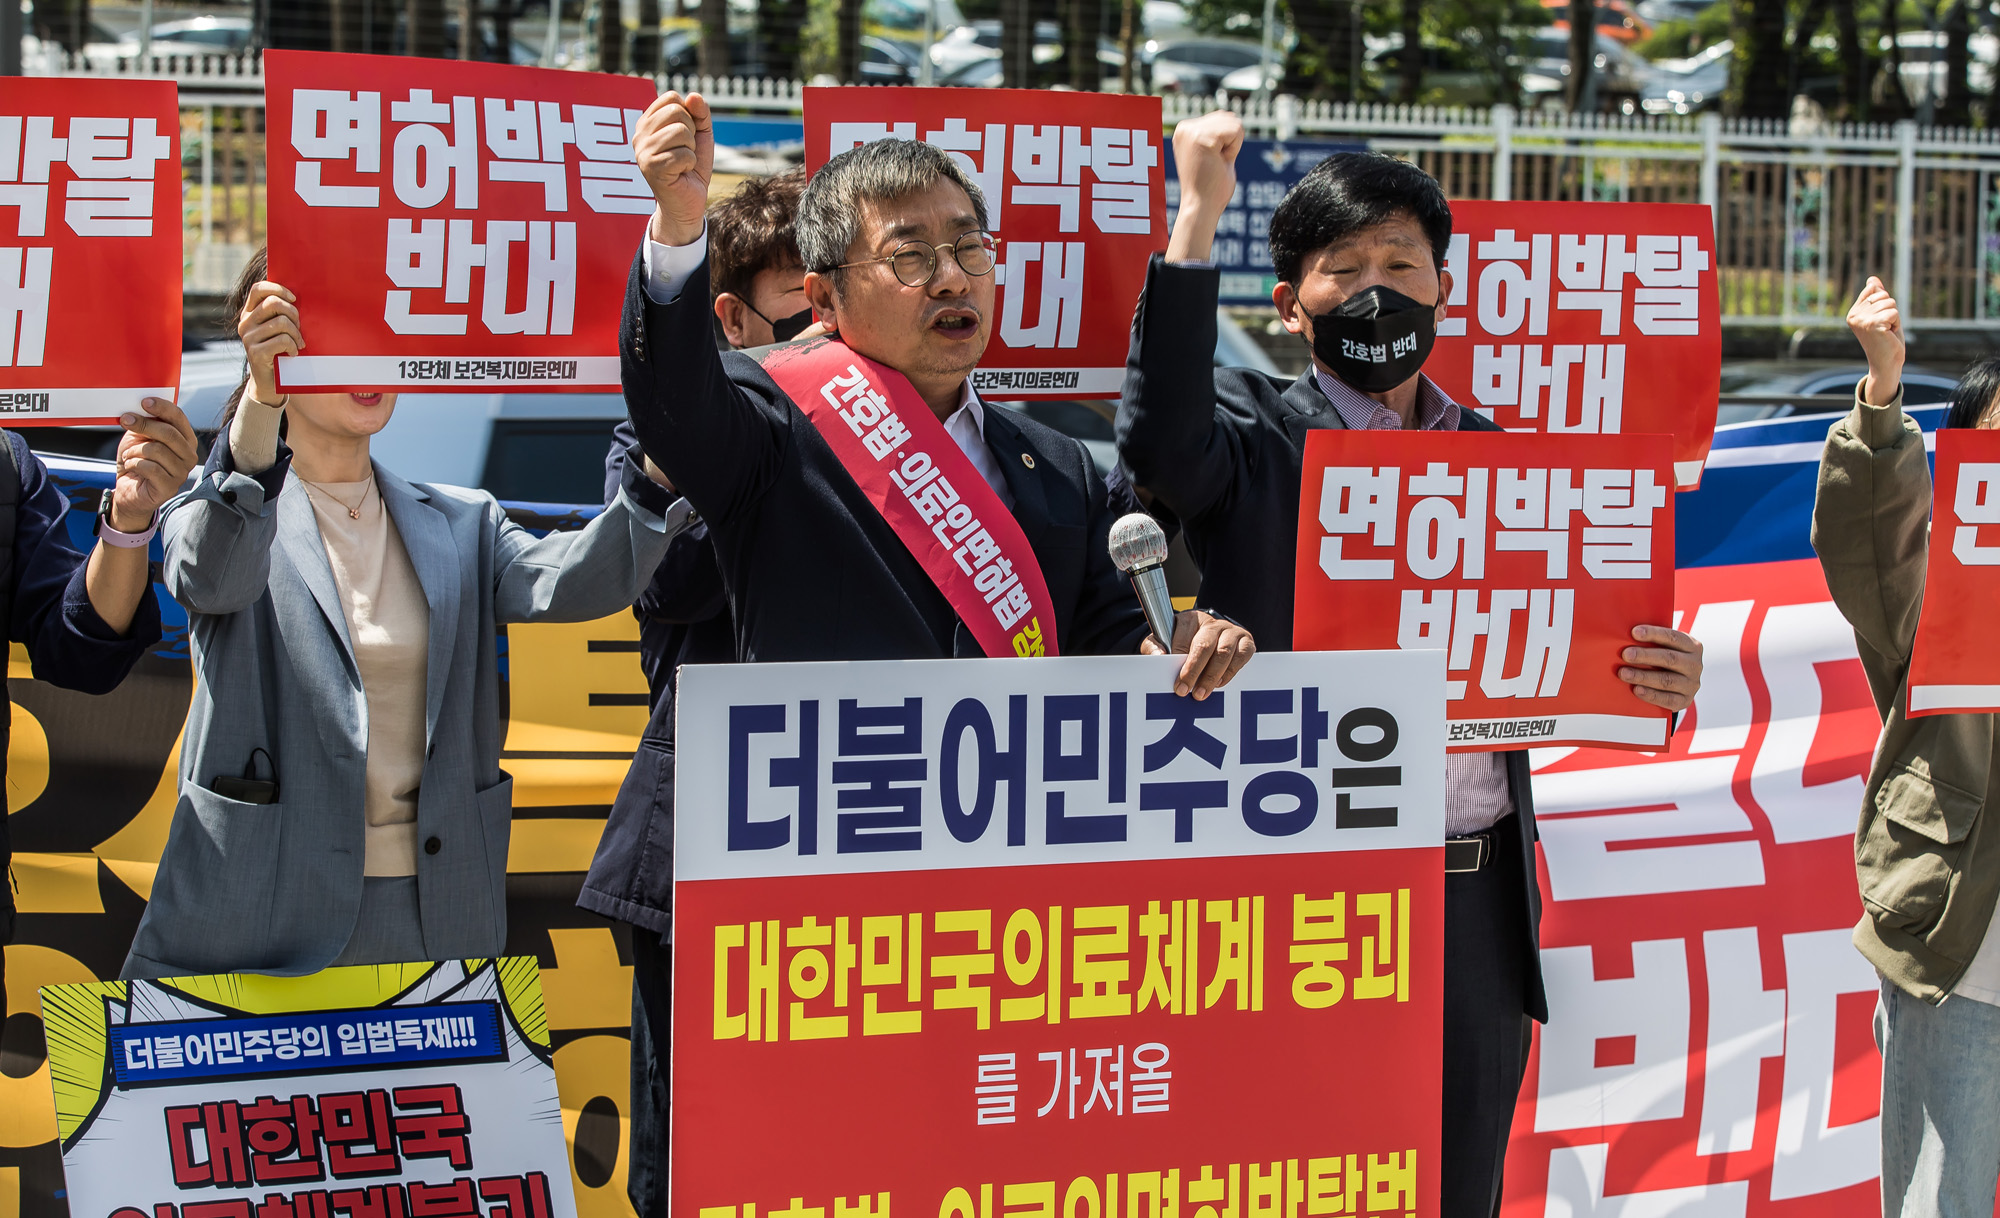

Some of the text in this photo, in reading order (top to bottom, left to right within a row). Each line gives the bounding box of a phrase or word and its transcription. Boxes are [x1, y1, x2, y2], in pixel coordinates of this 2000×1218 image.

[831, 117, 1158, 235] 허박탈
[383, 218, 578, 335] 반대
[996, 241, 1086, 349] 대
[398, 360, 578, 380] 13단체 보건복지의료연대
[972, 371, 1080, 389] 보건복지의료연대
[1341, 331, 1417, 363] 간호법 반대
[1318, 462, 1667, 581] 면허박탈
[1448, 719, 1558, 742] 보건복지의료연대
[712, 888, 1411, 1043] 대한민국의료체계 붕괴
[124, 1016, 478, 1070] 더불어민주당의 입법독재!!!
[974, 1042, 1173, 1126] 를 가져올
[163, 1083, 474, 1190] 대한민국
